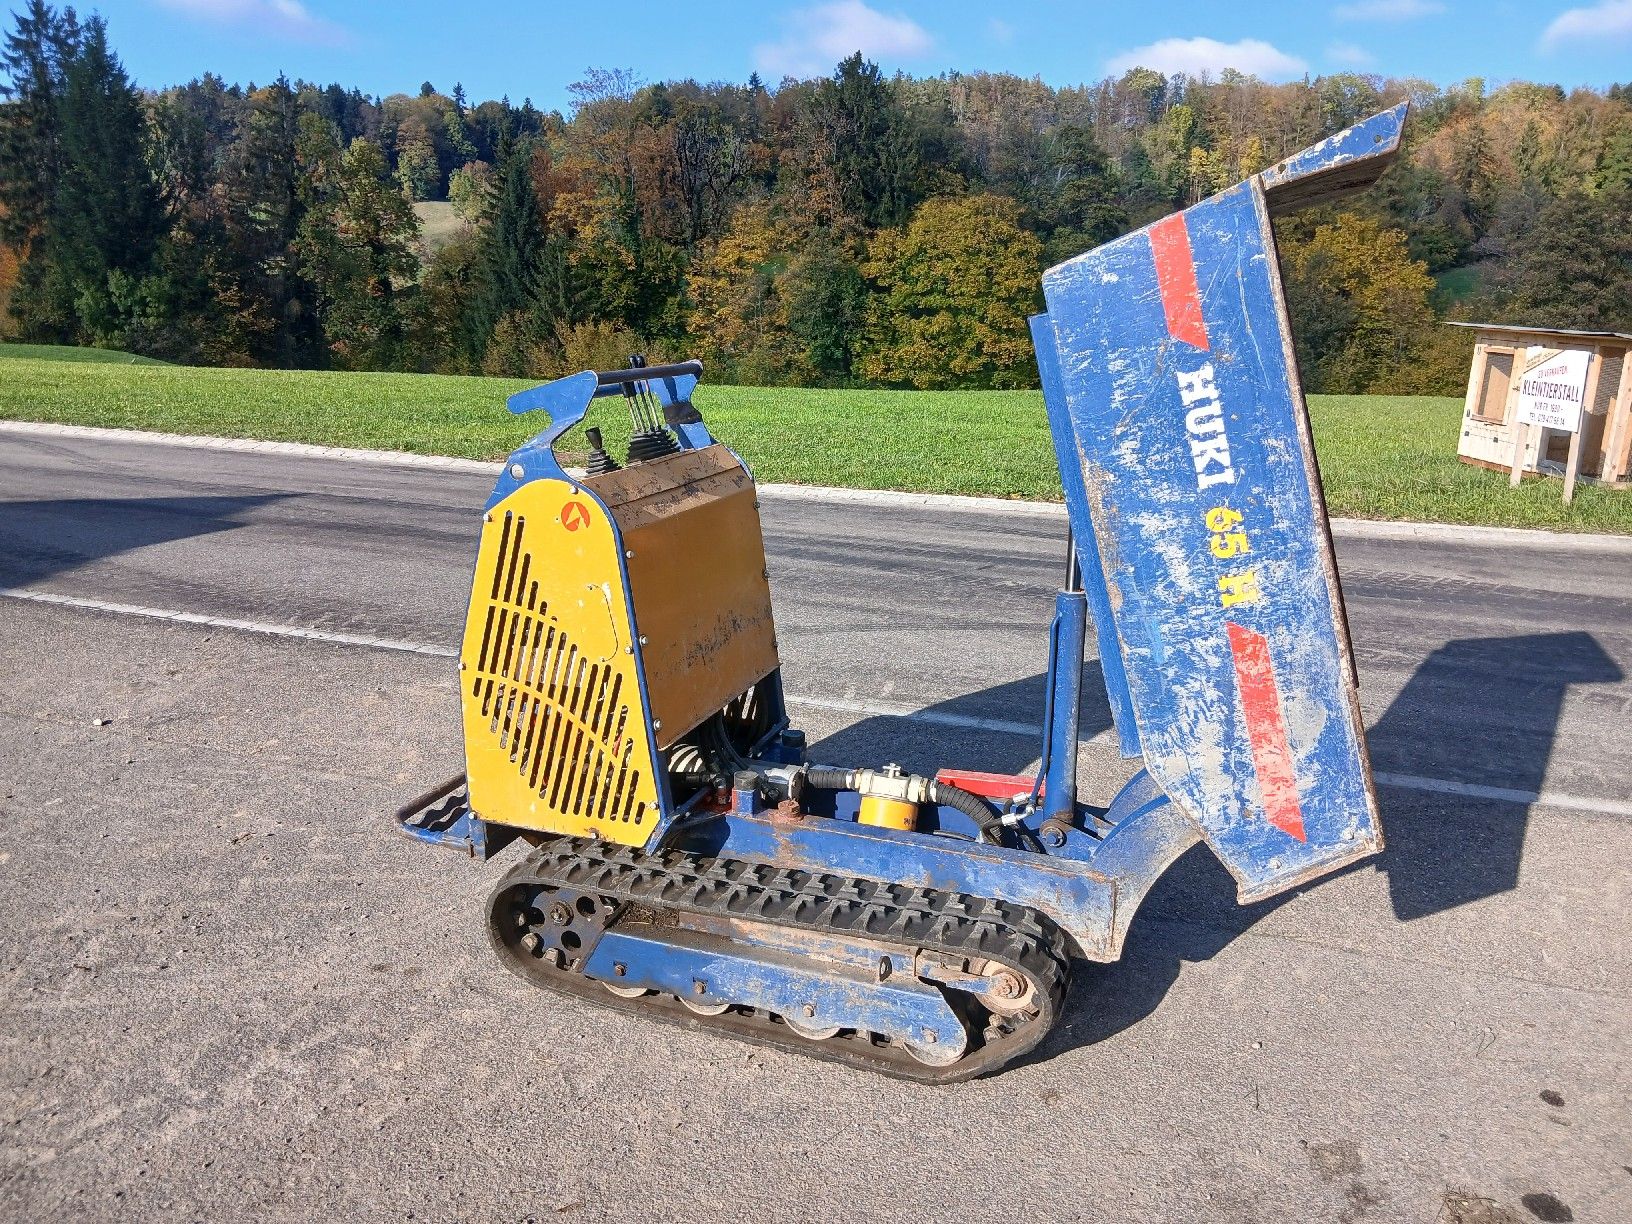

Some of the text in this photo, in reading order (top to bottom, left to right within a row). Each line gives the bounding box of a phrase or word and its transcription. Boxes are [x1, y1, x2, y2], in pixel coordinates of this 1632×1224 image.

[1523, 380, 1579, 402] KLEINTIERSTALL
[1176, 362, 1260, 608] HUKI 65 H
